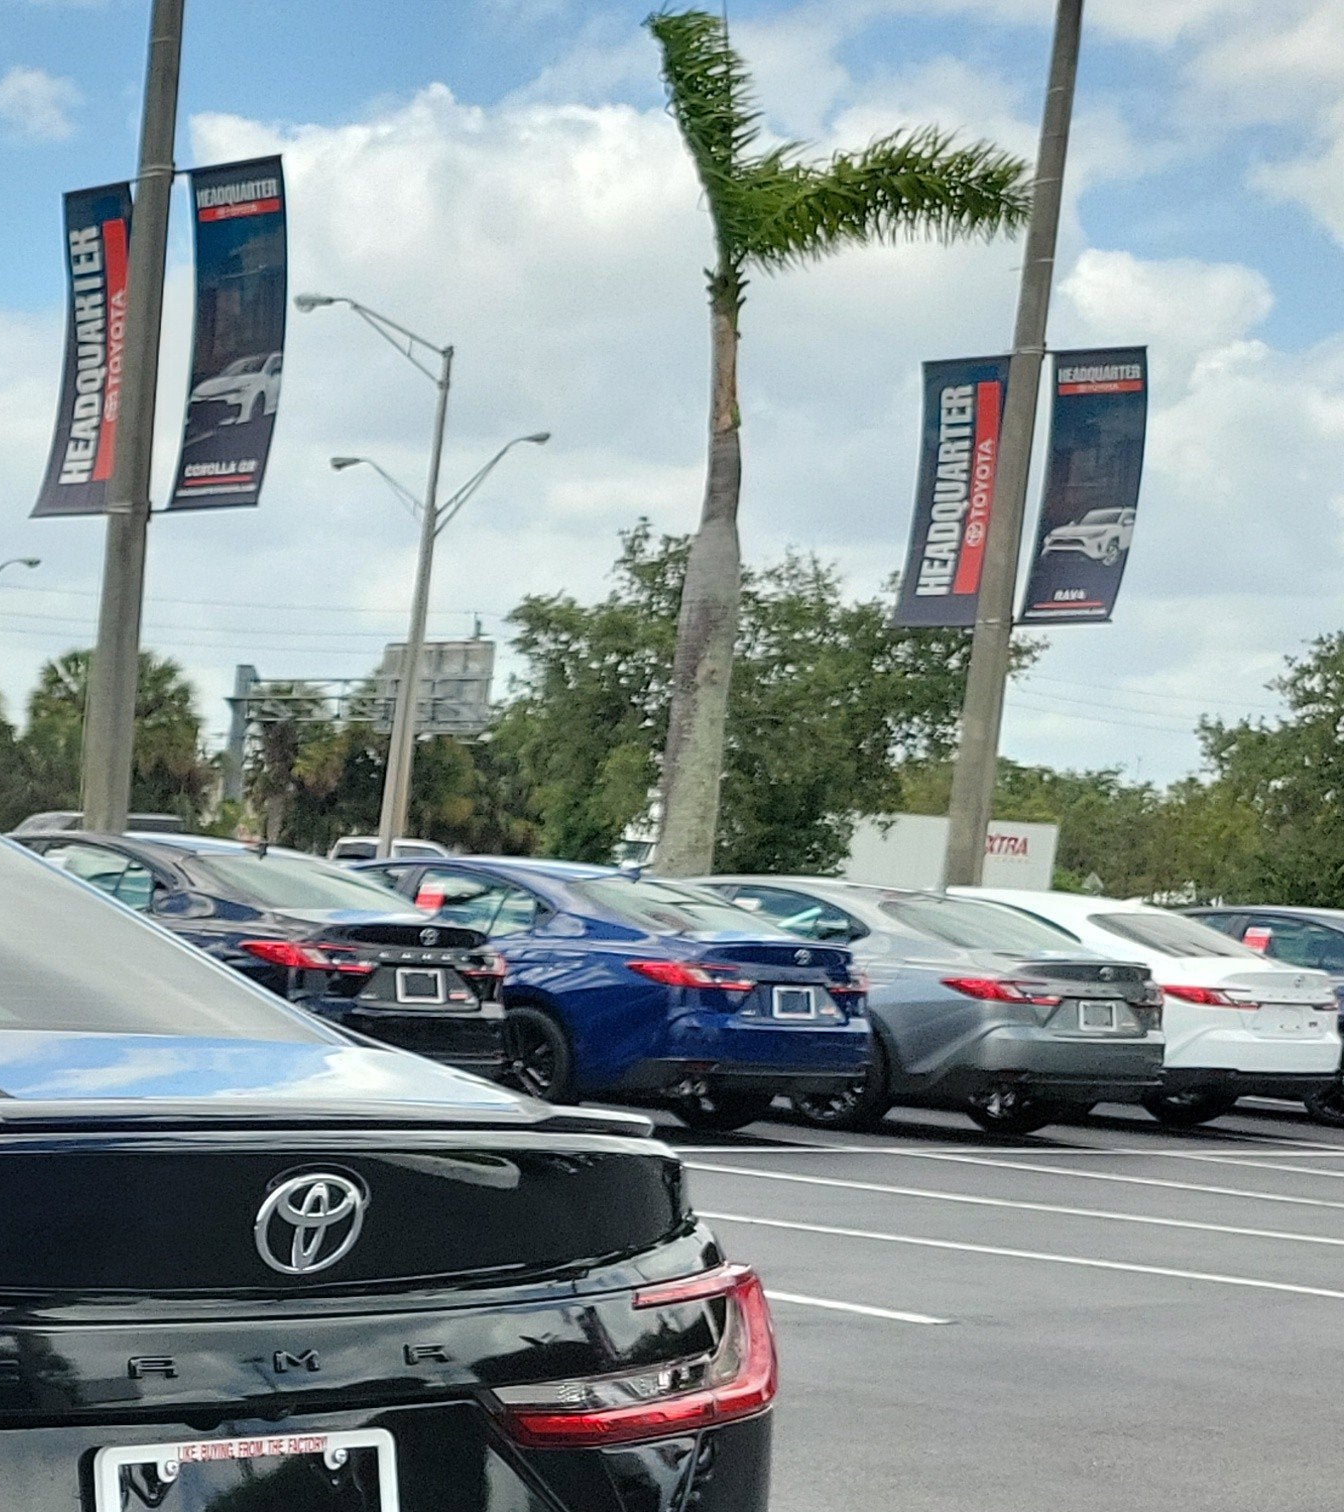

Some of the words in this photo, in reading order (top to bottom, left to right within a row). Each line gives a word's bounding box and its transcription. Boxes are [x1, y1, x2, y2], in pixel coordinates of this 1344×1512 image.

[197, 178, 278, 208] HEADQUARTER
[58, 224, 108, 484] HEADQUARTER
[107, 288, 127, 387] TOYOTA
[1058, 364, 1141, 384] HEADQUARTER
[916, 383, 974, 596] HEADQUARTER
[970, 438, 994, 520] TOYOTA
[268, 1439, 284, 1456] THE
